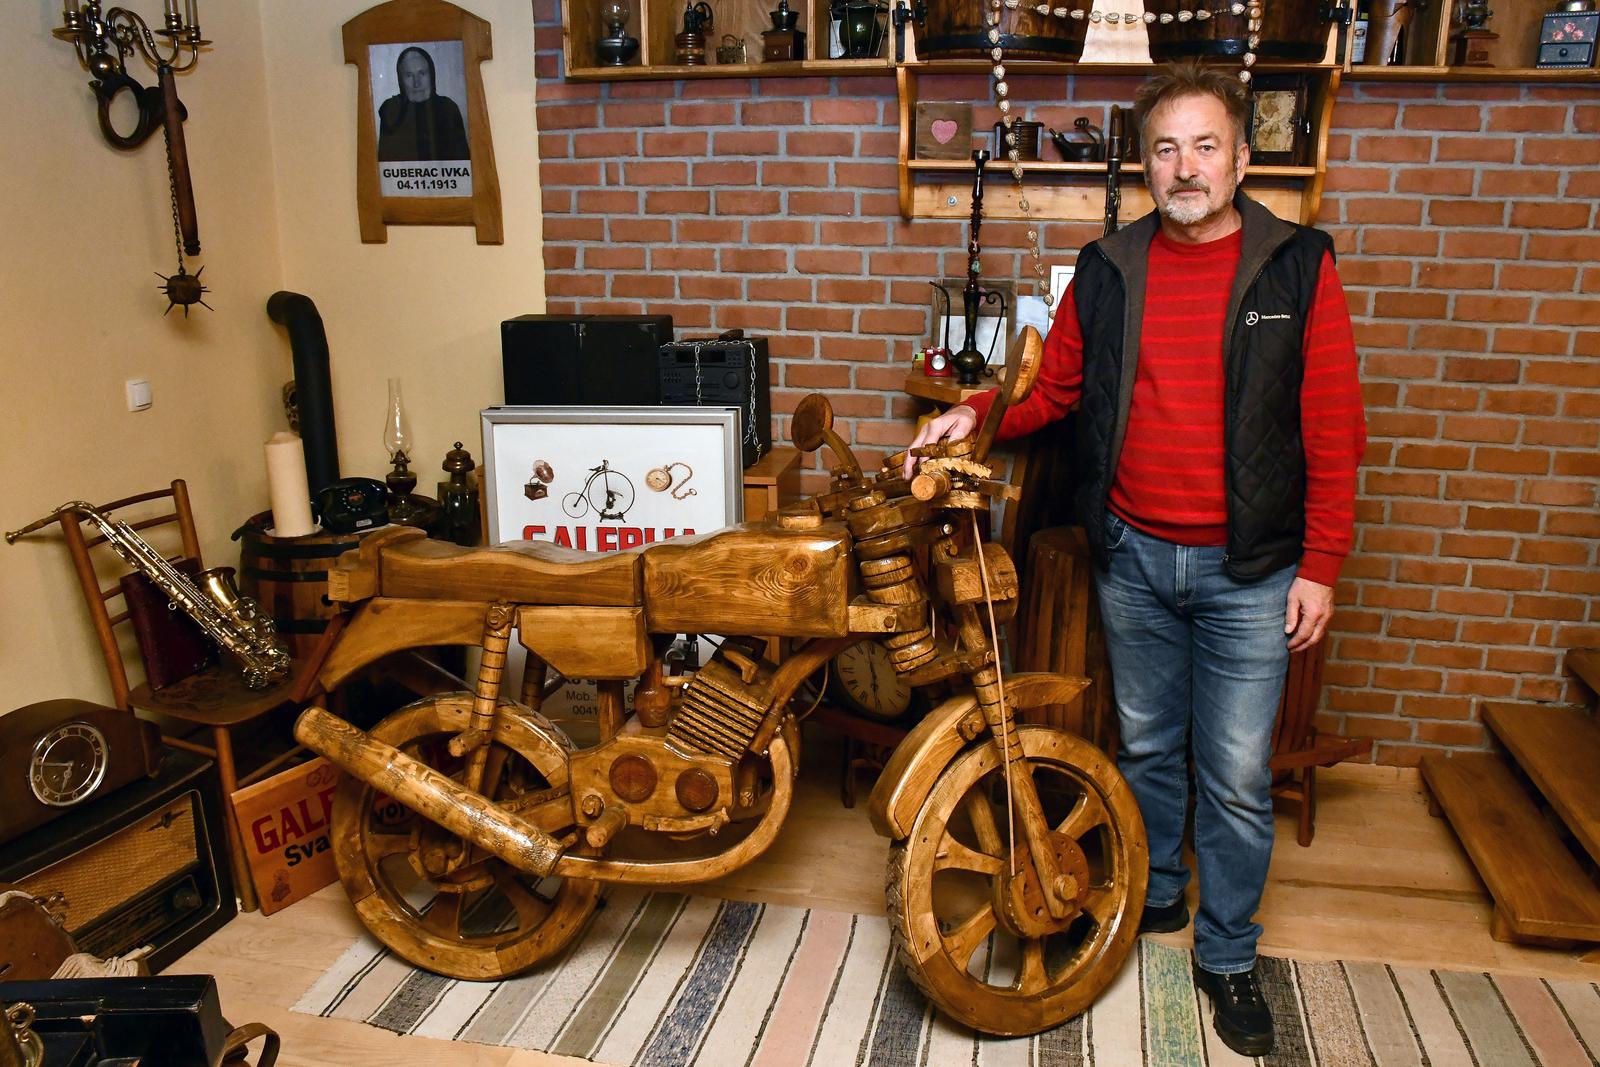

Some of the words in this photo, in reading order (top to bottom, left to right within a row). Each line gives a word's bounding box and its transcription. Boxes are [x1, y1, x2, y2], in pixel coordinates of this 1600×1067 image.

[383, 168, 438, 178] GUBERAC
[441, 168, 470, 177] IVKA
[397, 179, 457, 189] 04.11.1913
[523, 525, 696, 552] ALER
